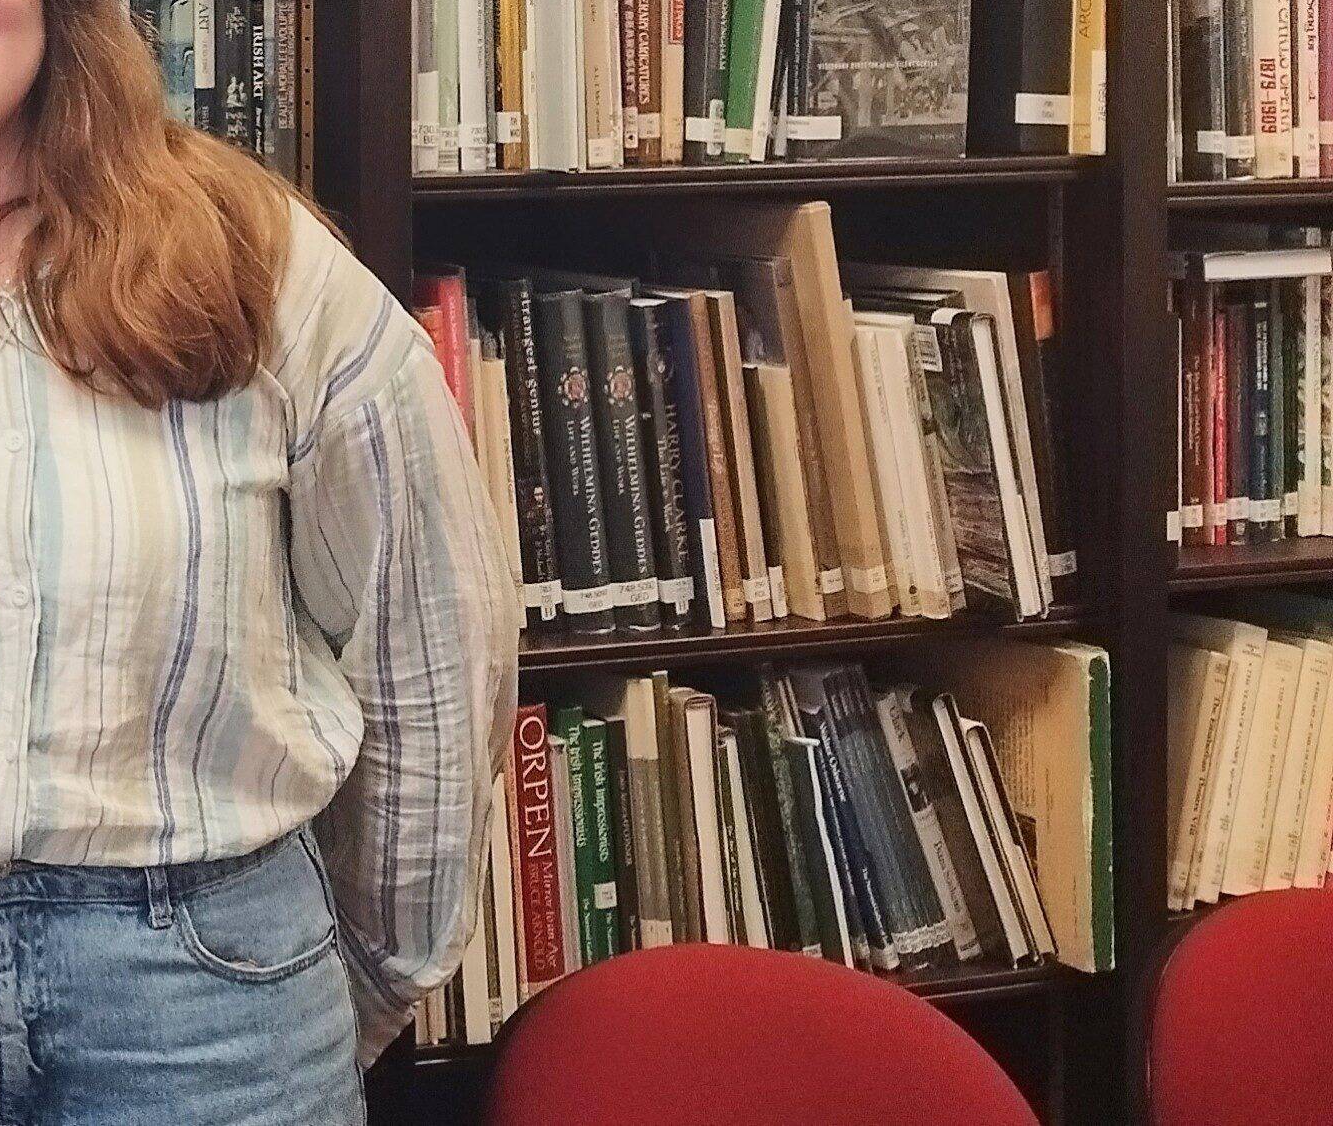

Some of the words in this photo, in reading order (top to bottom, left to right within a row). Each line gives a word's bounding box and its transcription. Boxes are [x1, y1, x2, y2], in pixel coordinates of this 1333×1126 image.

[197, 2, 210, 34] ART
[251, 24, 264, 69] IRISH
[1306, 34, 1317, 52] for
[624, 10, 637, 95] BEARDSLEY
[637, 32, 650, 105] CARICATURES
[251, 69, 264, 101] ART
[1258, 57, 1277, 135] 1879-1909
[520, 291, 537, 372] strangest
[527, 376, 542, 436] genius
[579, 415, 597, 515] WILHELMINA
[665, 403, 680, 472] HARRY
[623, 413, 641, 513] WILHELMINA
[632, 515, 648, 574] GEDDES
[671, 478, 689, 564] CLARKE
[587, 517, 603, 576] GEDDES
[567, 725, 581, 746] The
[1210, 696, 1220, 716] The
[568, 746, 584, 772] Irish
[591, 740, 604, 761] The
[593, 761, 606, 786] Irish
[518, 715, 552, 858] ORPEN
[570, 772, 587, 848] Impressionists
[594, 788, 610, 863] Impressionists
[528, 861, 541, 907] BRUCE
[540, 860, 554, 908] Mirror
[531, 912, 546, 970] ARNOLD
